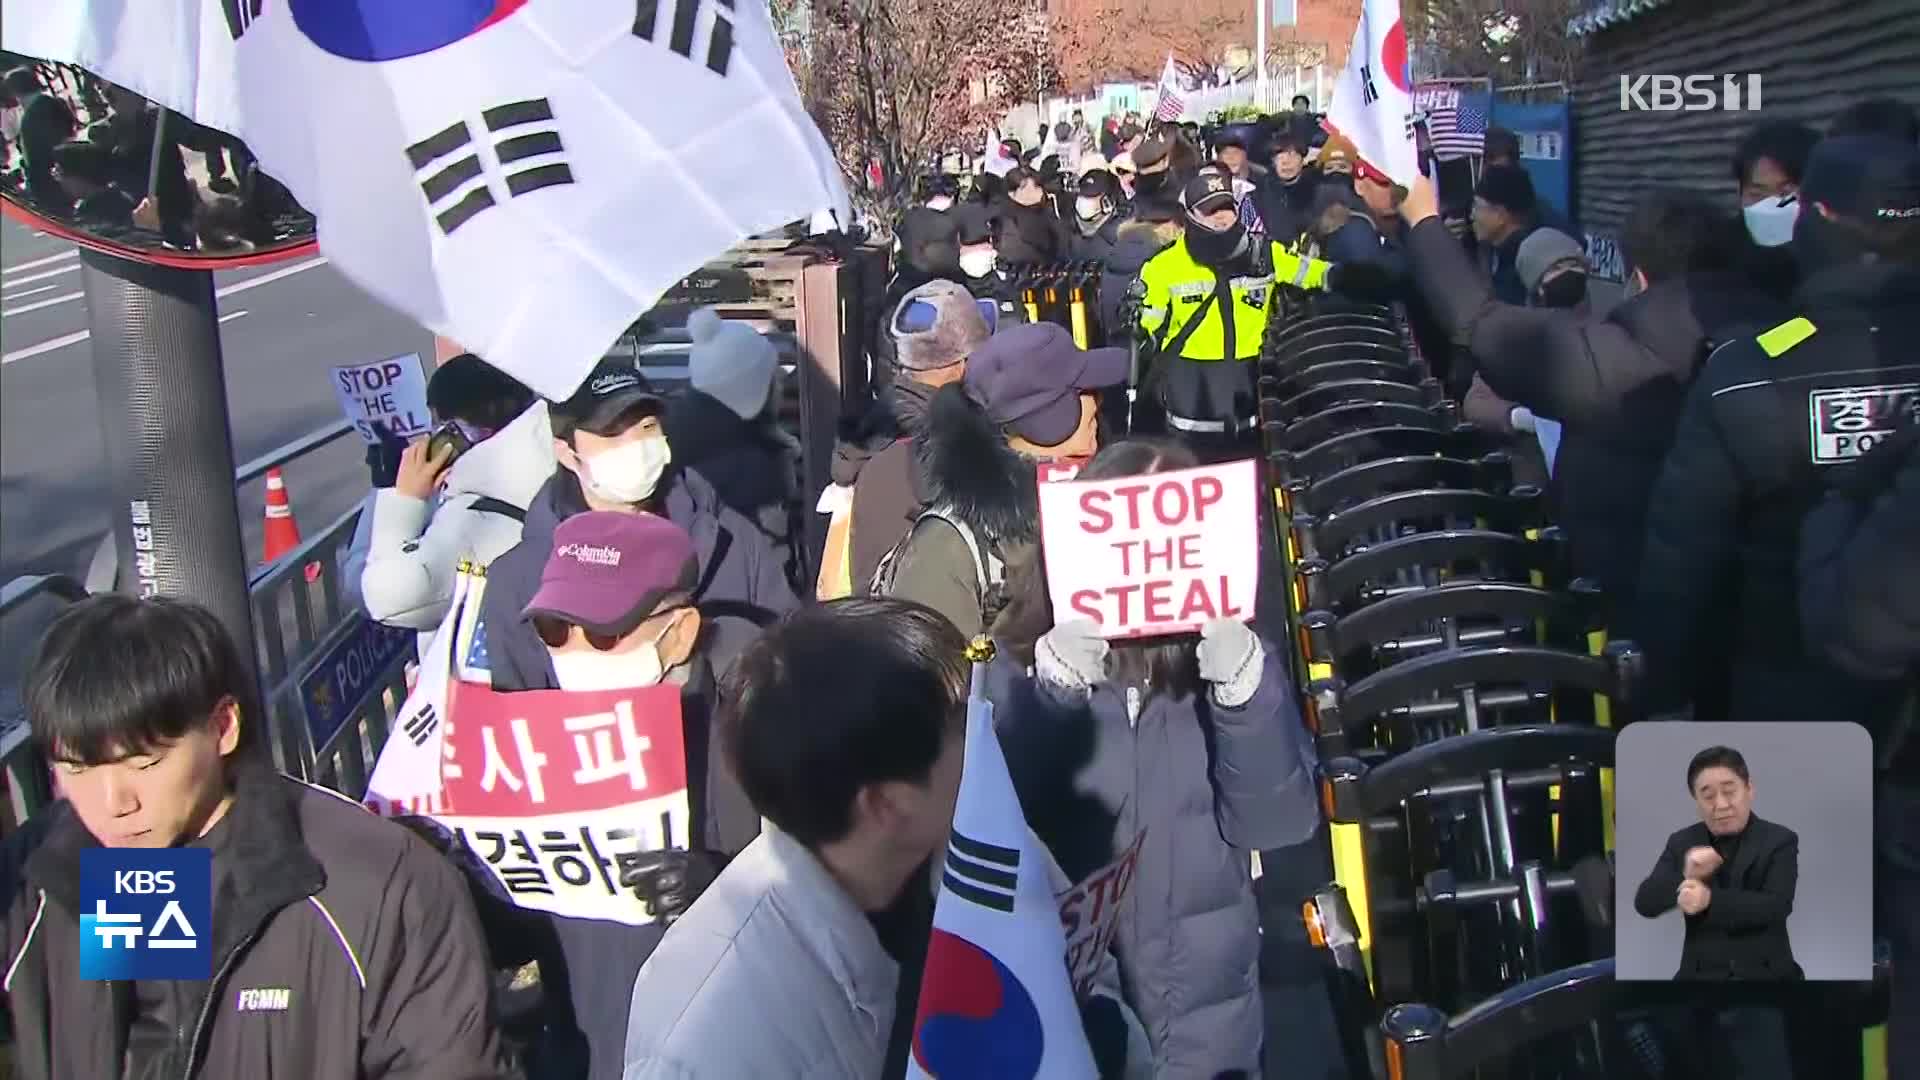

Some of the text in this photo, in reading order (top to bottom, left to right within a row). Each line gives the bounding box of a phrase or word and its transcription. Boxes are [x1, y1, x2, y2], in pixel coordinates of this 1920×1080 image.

[338, 363, 402, 393] STOP
[357, 411, 426, 441] SAL
[1079, 476, 1223, 534] STOP
[1110, 534, 1203, 577] THE
[1070, 575, 1241, 627] STEAL
[238, 989, 291, 1010] FCMM
